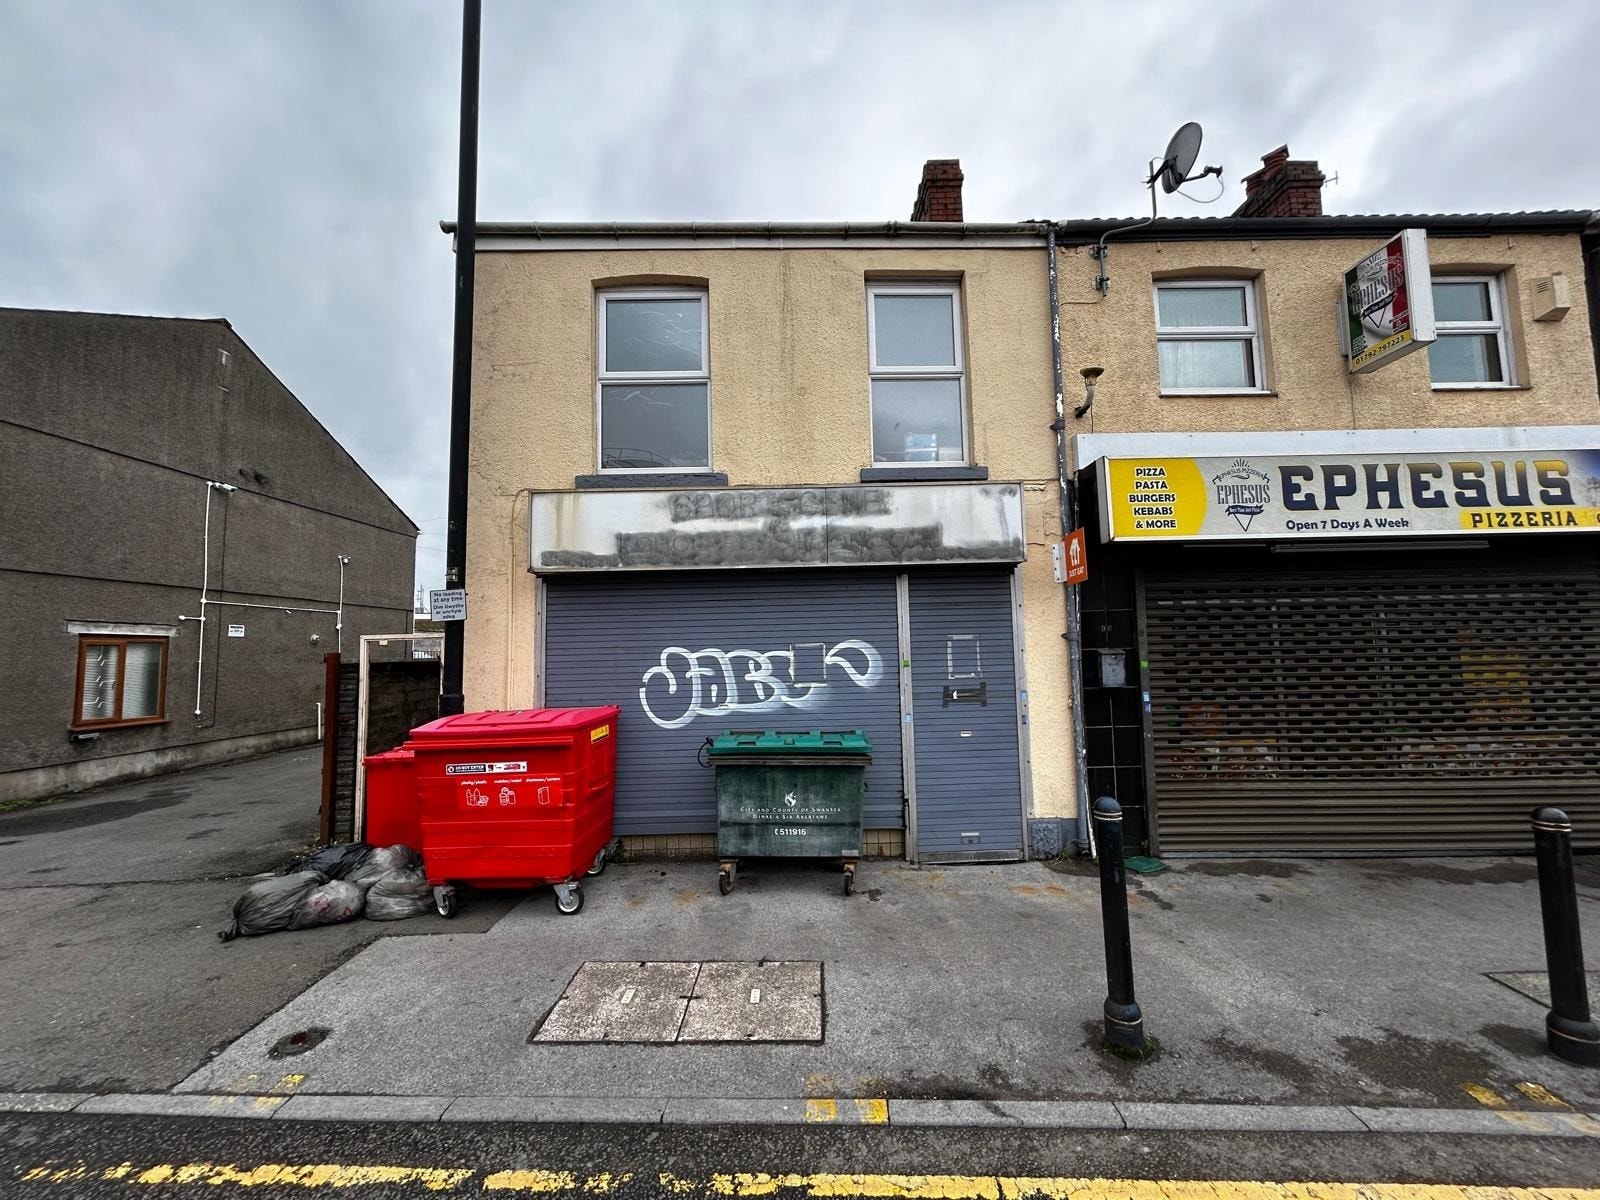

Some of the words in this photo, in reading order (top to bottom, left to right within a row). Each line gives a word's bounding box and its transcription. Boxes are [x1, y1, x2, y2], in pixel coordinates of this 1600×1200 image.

[1135, 467, 1166, 477] PIZZA
[1135, 481, 1168, 490] PASTA
[1278, 460, 1576, 511] EPHESUS
[1128, 493, 1176, 503] BURGERS
[1216, 484, 1271, 505] EPHESUS
[1133, 506, 1173, 516] KEBABS
[1135, 520, 1143, 529] &
[1145, 519, 1177, 529] MORE
[1285, 519, 1319, 531] Open
[1320, 520, 1328, 529] 7
[1330, 519, 1360, 530] Days
[1363, 518, 1373, 528] A
[1375, 517, 1410, 528] Week
[1471, 511, 1578, 528] PIZZERIA
